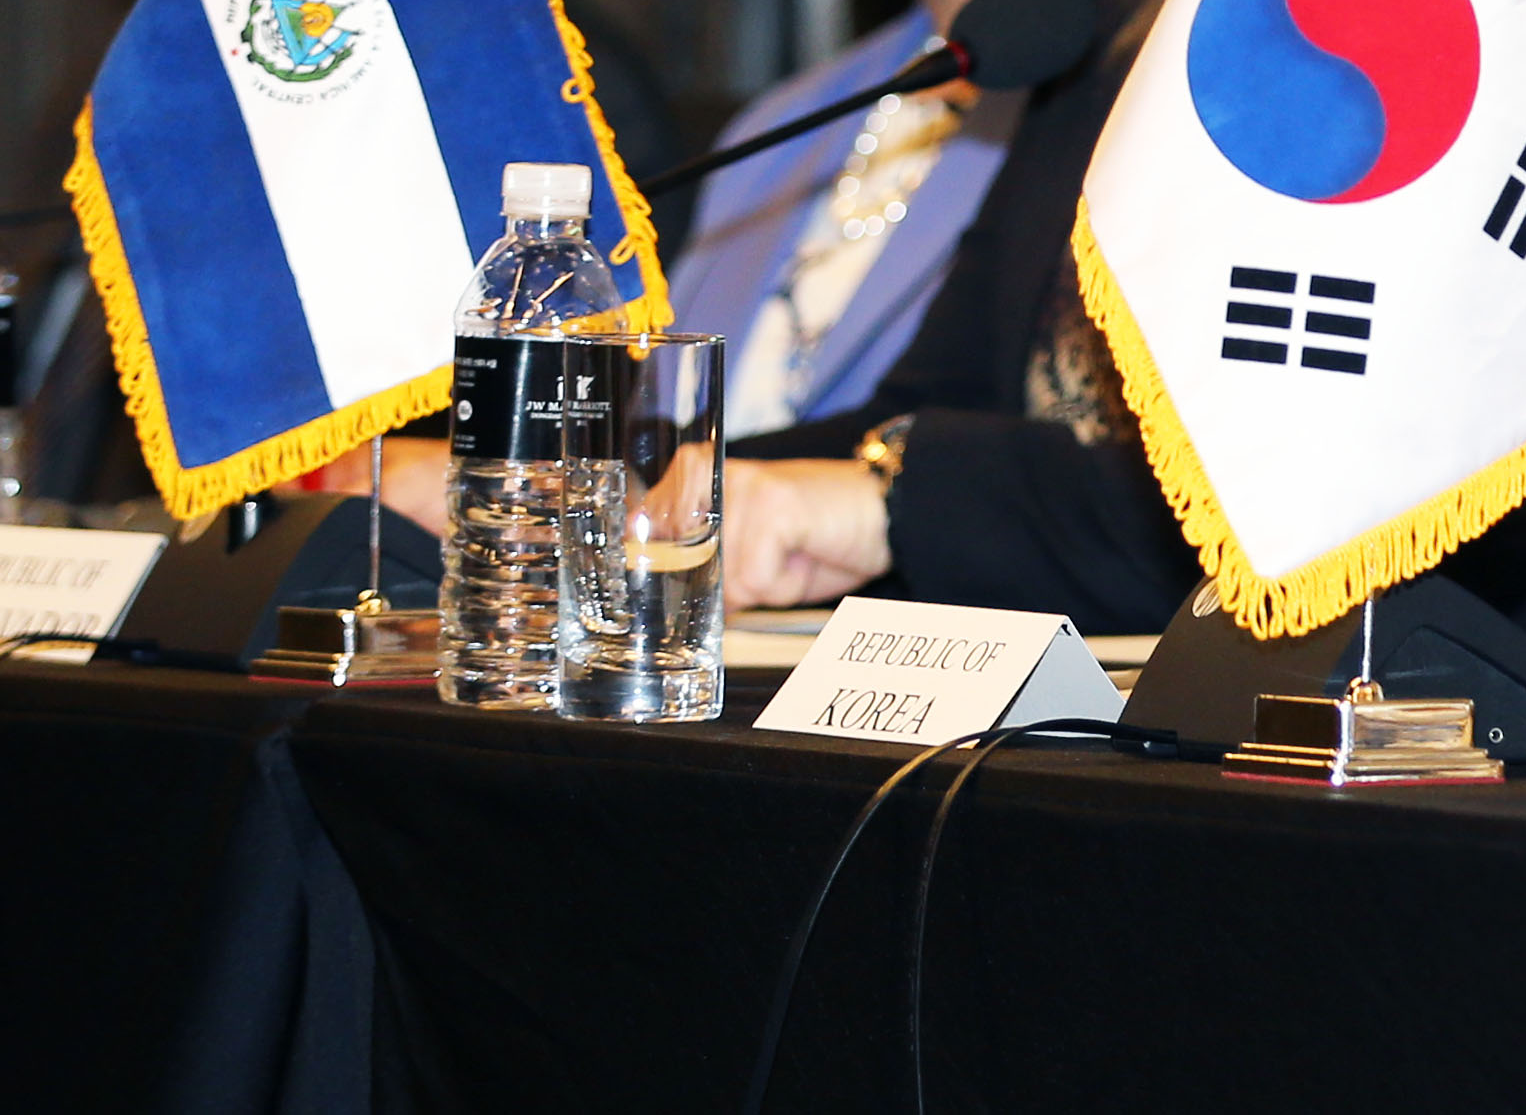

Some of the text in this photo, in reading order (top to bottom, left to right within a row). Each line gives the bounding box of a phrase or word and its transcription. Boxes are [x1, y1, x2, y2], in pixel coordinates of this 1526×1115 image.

[838, 631, 1007, 673] REPUBLIC OF
[811, 688, 938, 735] KOREA
